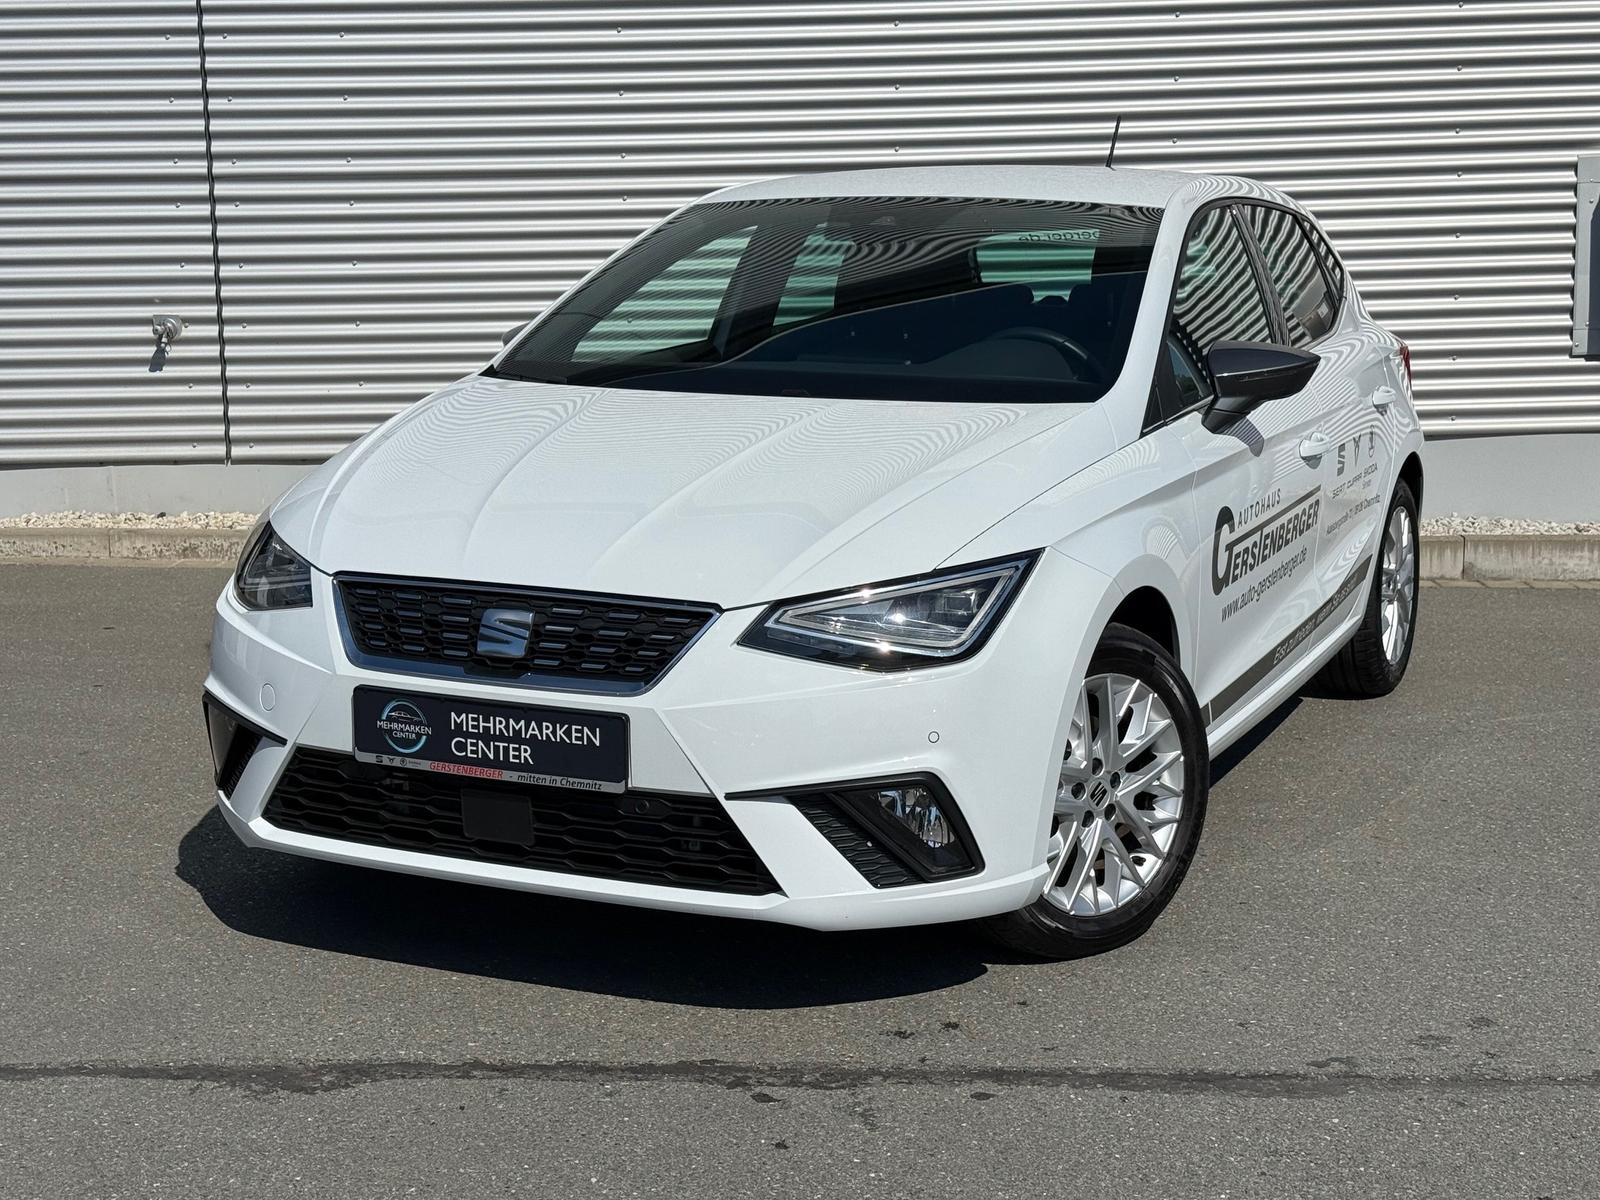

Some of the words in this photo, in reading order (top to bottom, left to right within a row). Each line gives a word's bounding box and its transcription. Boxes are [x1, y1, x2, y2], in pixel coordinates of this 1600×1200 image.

[1237, 488, 1281, 529] AUTOHAUS
[1212, 485, 1321, 596] GERSTENBERGER
[1221, 545, 1307, 622] www.auto-gerstenberger.de
[376, 719, 432, 735] MEHRMARKEN
[392, 729, 417, 740] CENTER
[450, 711, 601, 747] MEHRMARKEN
[450, 737, 534, 765] CENTER
[429, 761, 504, 779] GERSTENBERGER
[517, 773, 547, 786] mitten
[548, 775, 558, 786] in
[559, 776, 602, 791] Chemnitz
